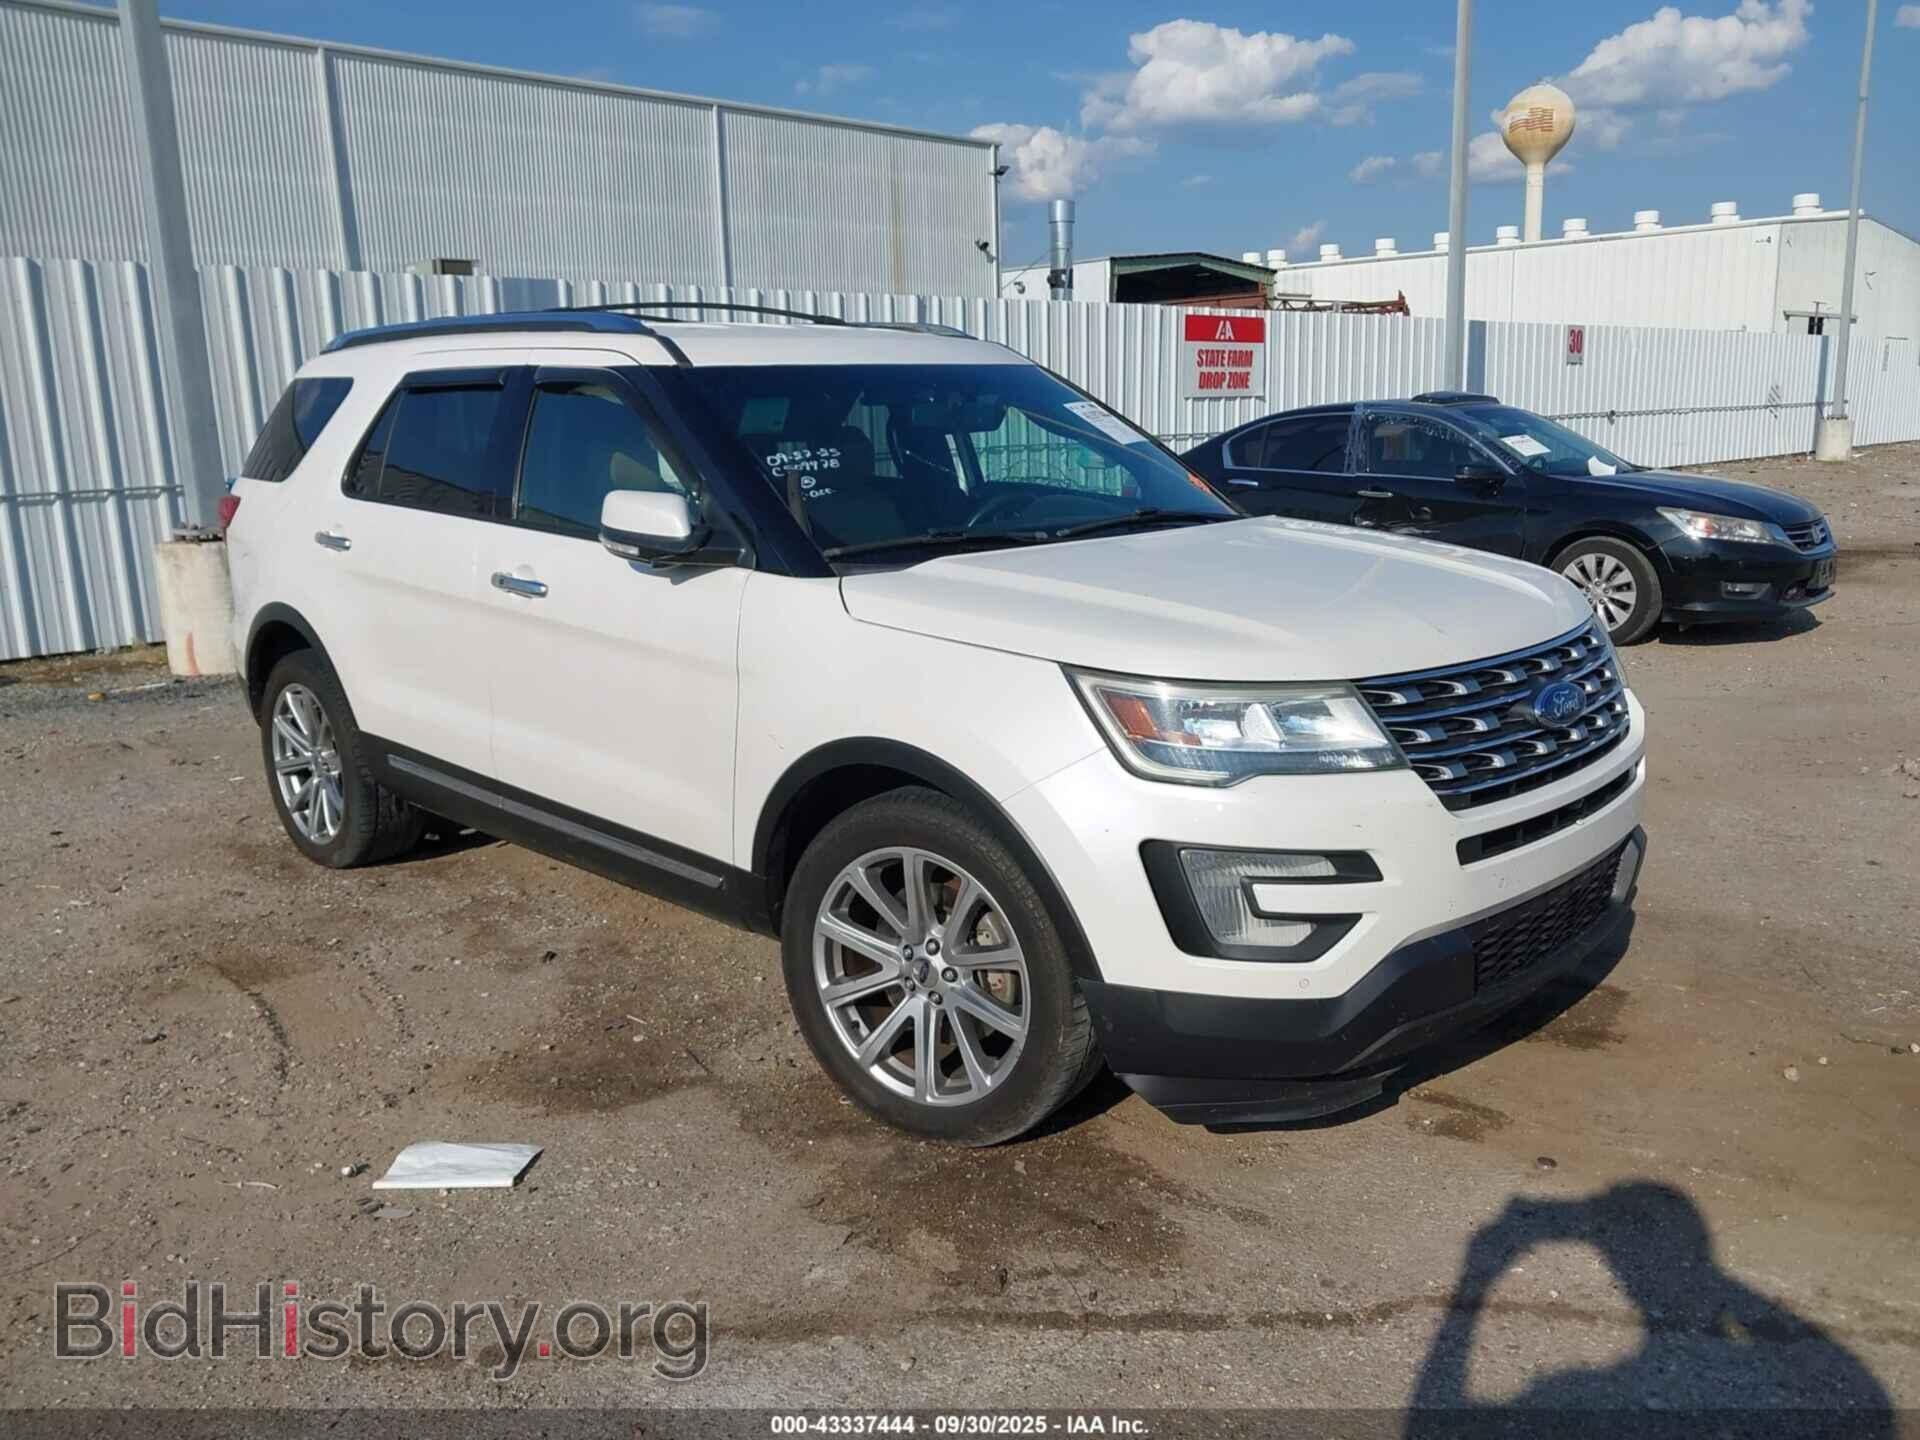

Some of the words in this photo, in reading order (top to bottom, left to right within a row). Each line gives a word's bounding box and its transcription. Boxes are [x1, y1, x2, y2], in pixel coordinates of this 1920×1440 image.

[1569, 328, 1583, 354] 30
[1196, 349, 1226, 368] STATE
[1227, 350, 1254, 368] FARM
[1198, 371, 1226, 389] DROP
[1226, 371, 1250, 389] ZONE
